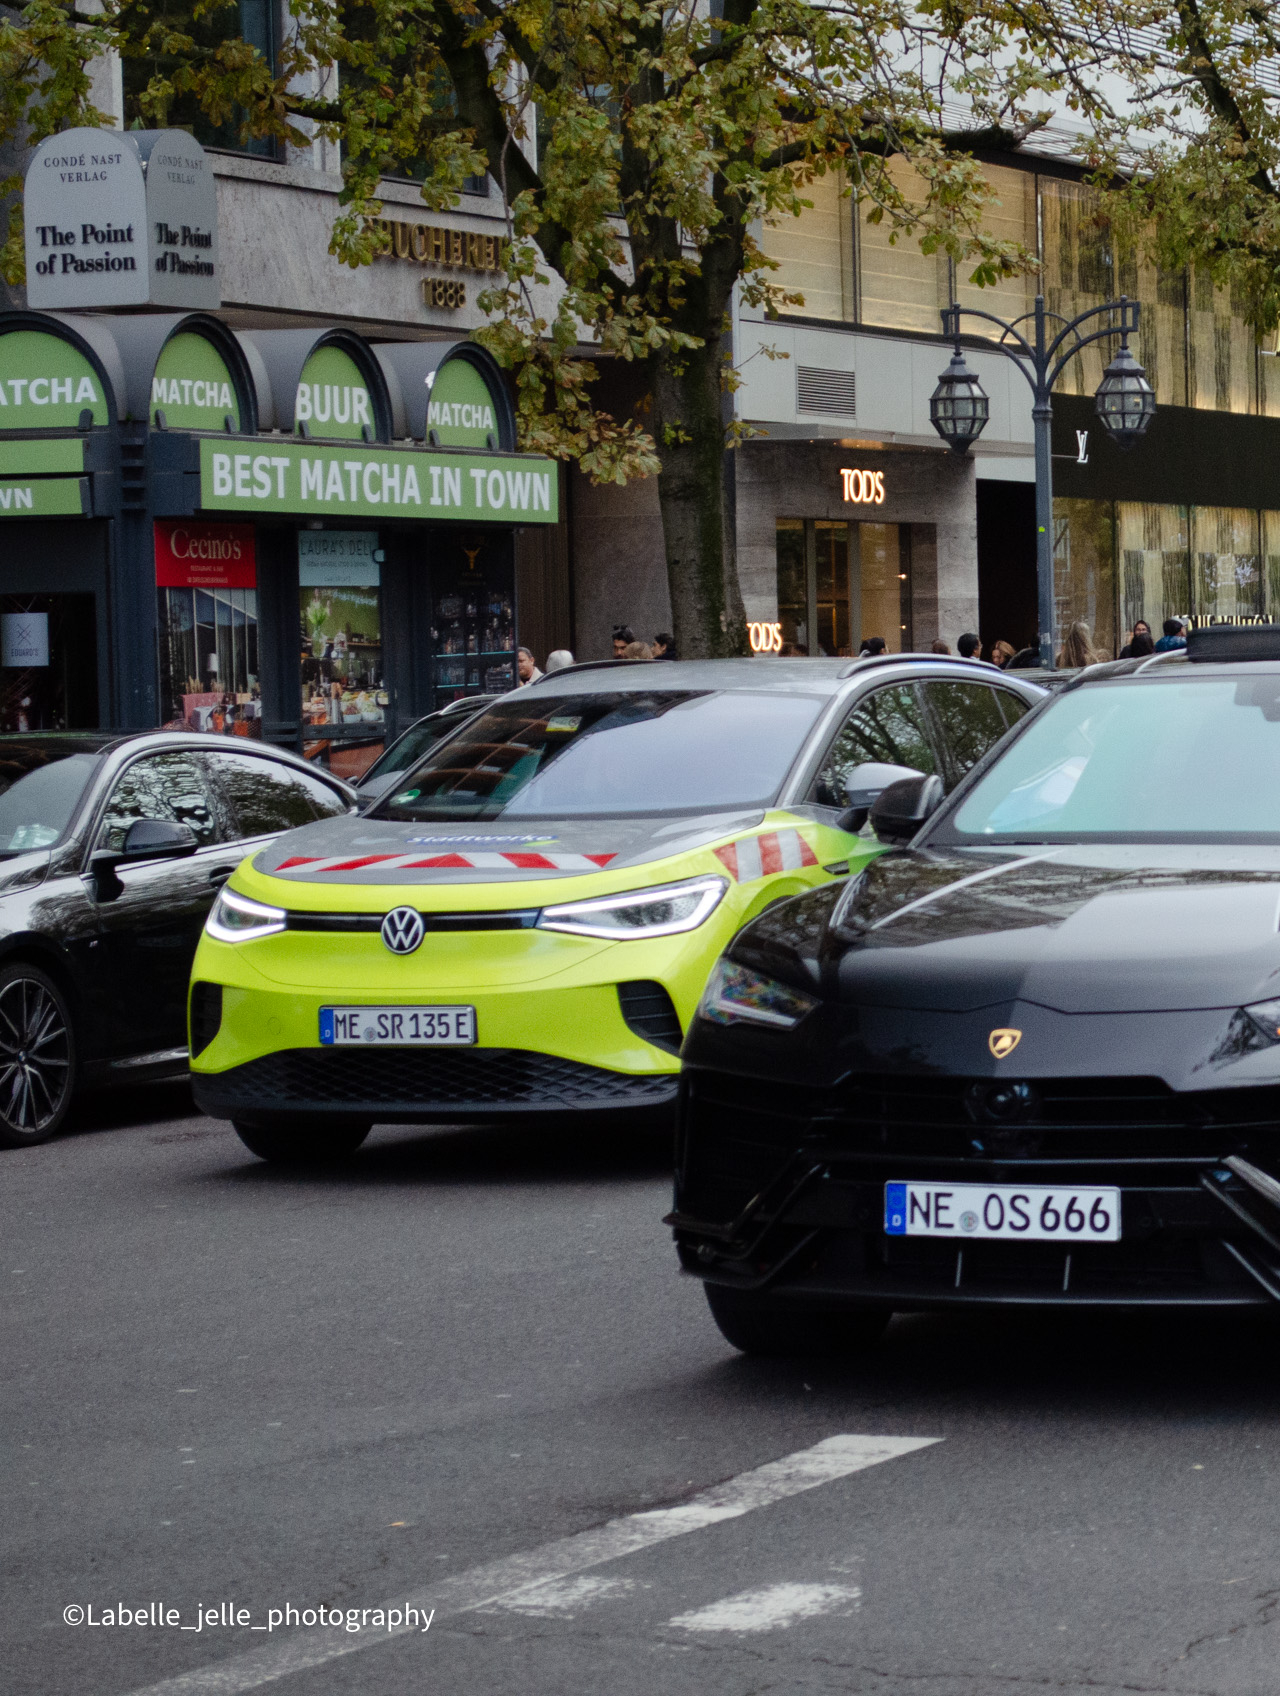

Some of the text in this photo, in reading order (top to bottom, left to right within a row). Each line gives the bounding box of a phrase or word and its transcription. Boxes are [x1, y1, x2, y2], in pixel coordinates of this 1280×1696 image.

[44, 154, 122, 167] CONDÉ NAST
[157, 154, 203, 170] CONDÉ NAST
[59, 170, 108, 183] VERLAG
[167, 172, 196, 185] VERLAG
[35, 223, 134, 247] The Point
[155, 222, 213, 249] The Point
[35, 251, 137, 275] of Passion
[155, 251, 215, 277] of Passion
[422, 277, 466, 308] 1888
[152, 377, 233, 409] MATCHA
[295, 382, 371, 425] BUUR
[427, 401, 494, 429] MATCHA
[213, 453, 550, 511] BEST MATCHA IN TOWN
[170, 528, 242, 560] Cecino's
[301, 539, 345, 556] LAURA'S
[334, 1013, 361, 1040] ME
[909, 1191, 955, 1229] NE
[1039, 1195, 1111, 1233] 666
